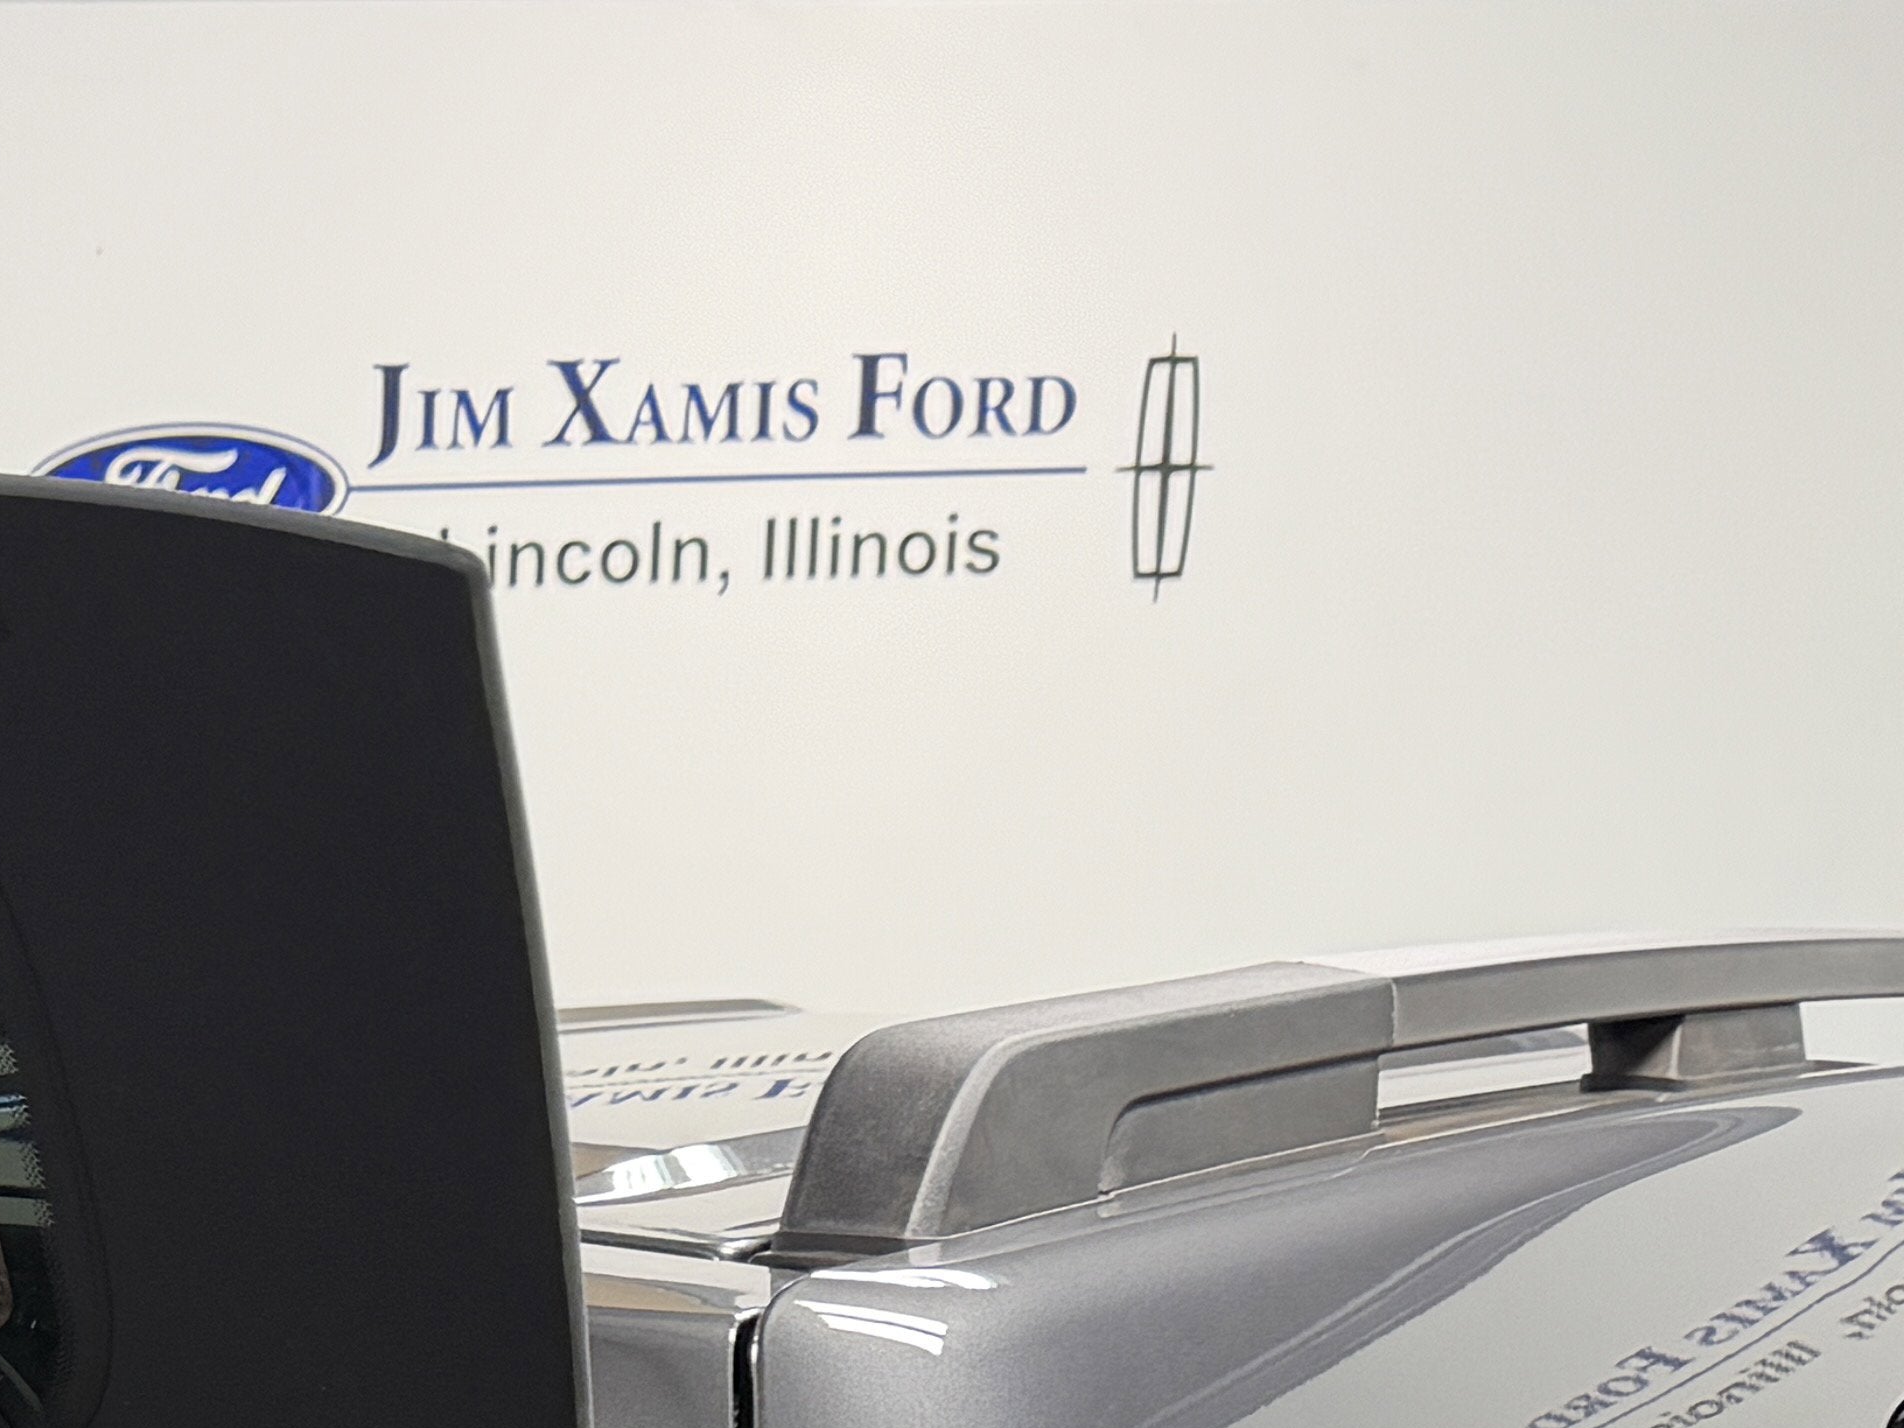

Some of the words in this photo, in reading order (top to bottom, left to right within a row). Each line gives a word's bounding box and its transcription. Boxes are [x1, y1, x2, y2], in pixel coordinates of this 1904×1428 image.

[367, 362, 515, 468] JIM
[542, 358, 821, 449] XAMIS
[846, 352, 1078, 441] FORD
[438, 511, 732, 597] incoln,
[762, 512, 1003, 580] Illinois
